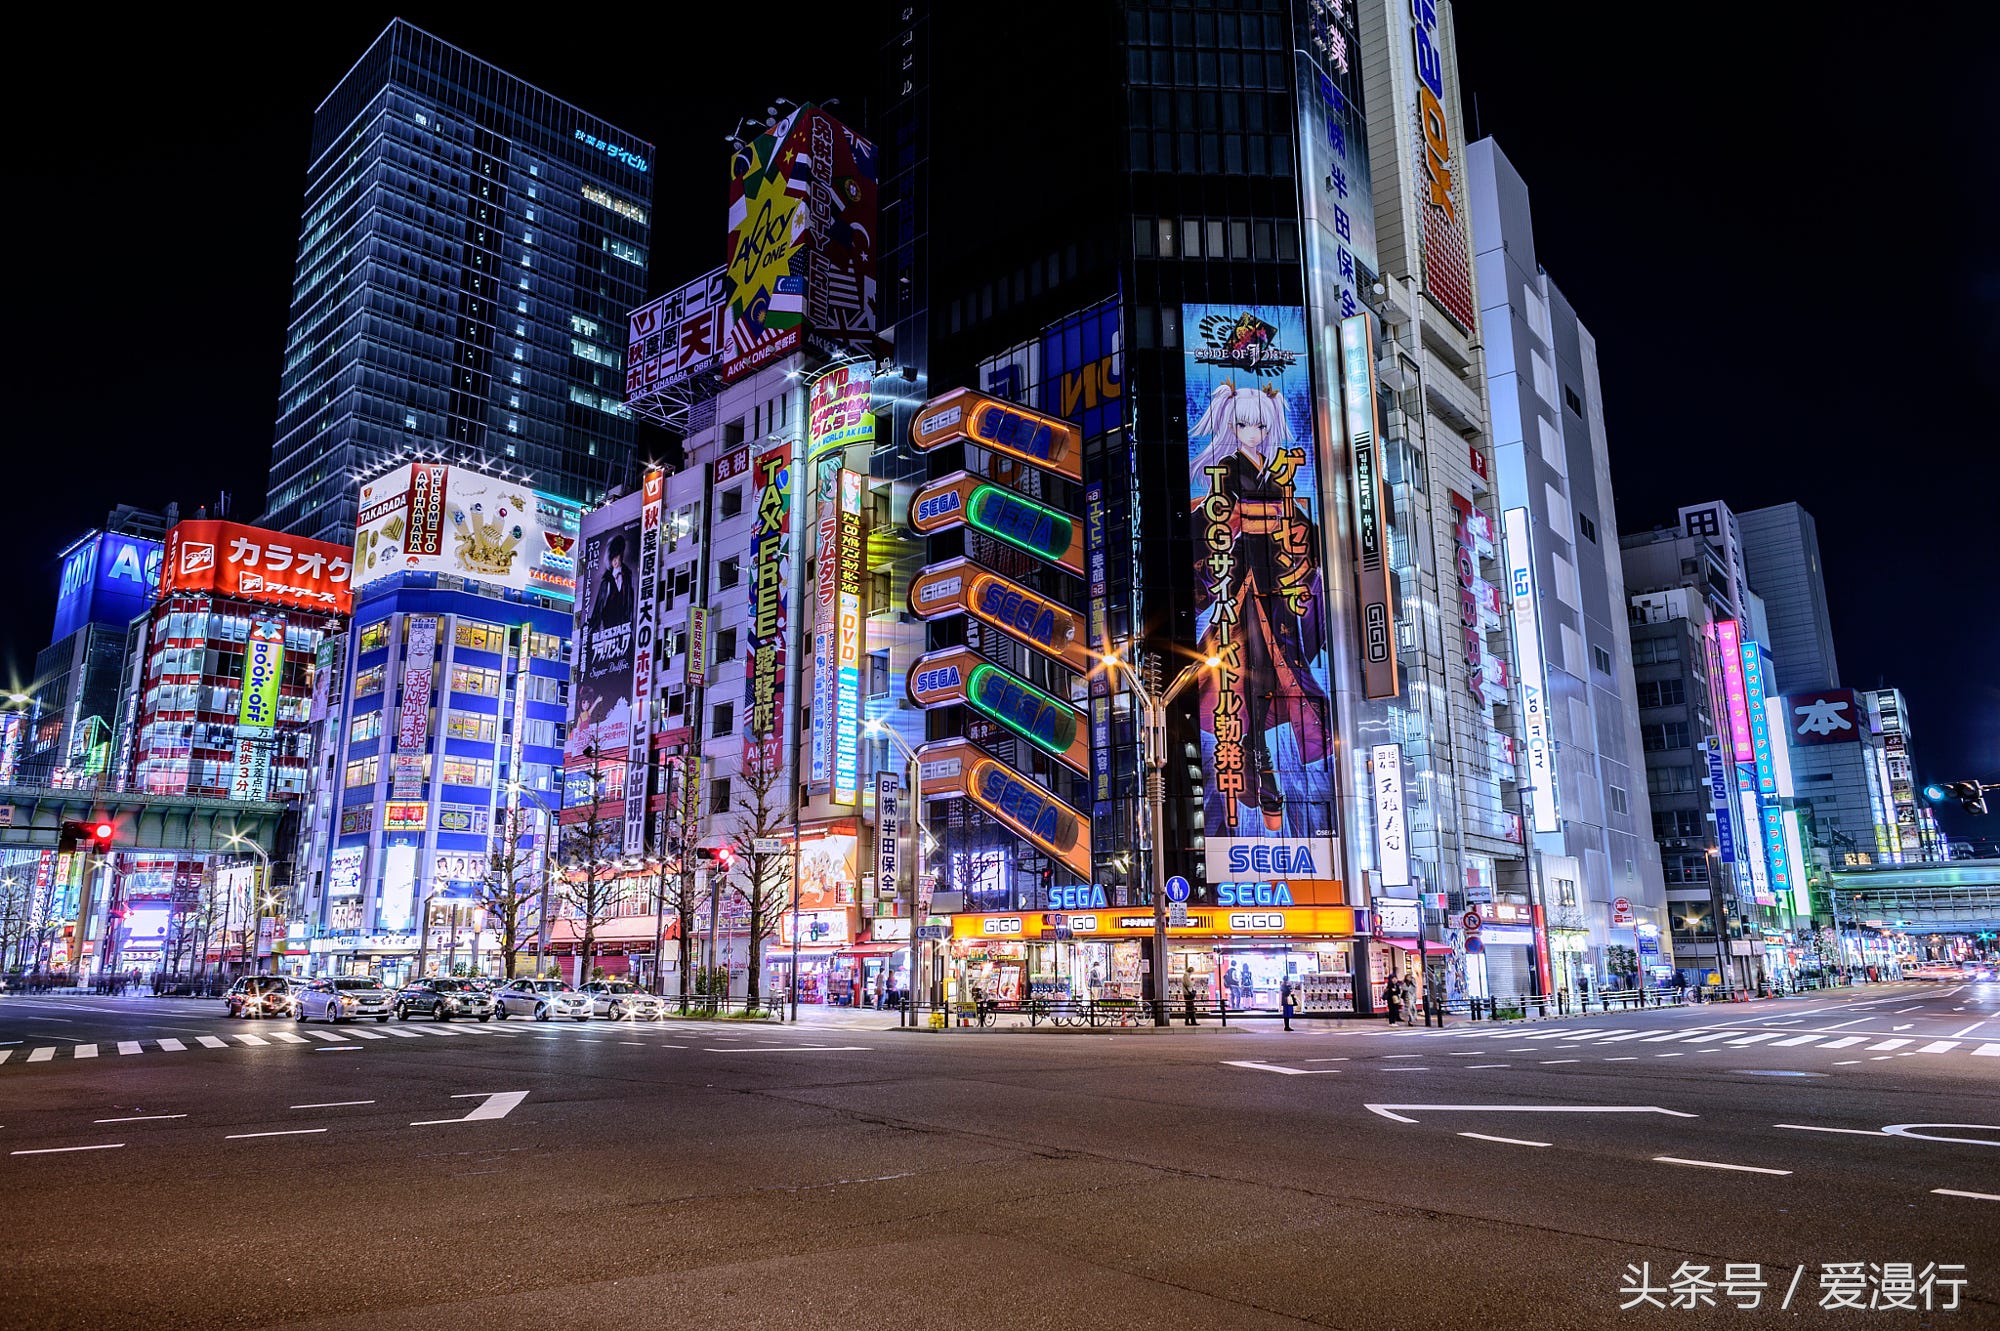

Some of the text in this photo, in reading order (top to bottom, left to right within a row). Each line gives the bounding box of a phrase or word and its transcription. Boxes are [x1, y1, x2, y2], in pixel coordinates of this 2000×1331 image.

[575, 129, 648, 172] 秋葉原ダイビル
[762, 242, 788, 268] ONE
[628, 327, 680, 365] 秋葉原
[1194, 343, 1297, 368] CODE OF JOKER
[627, 359, 678, 395] ホビー
[819, 367, 849, 391] DVD
[812, 411, 862, 440] ラムタラ
[822, 431, 844, 446] WORLD
[846, 425, 873, 439] AKIBA
[980, 408, 1053, 461] SEGA
[716, 451, 747, 480] 免税
[359, 494, 408, 525] TAKARADA
[408, 472, 428, 553] AKIHABARA
[424, 467, 443, 553] WELCOME TO
[760, 455, 784, 537] TAX
[918, 490, 960, 522] SEGA
[844, 525, 858, 536] CD
[981, 493, 1054, 550] SEGA
[1270, 447, 1312, 616] ゲーセンで
[60, 543, 96, 600] AOKI
[228, 537, 351, 583] カラオケ
[818, 517, 836, 606] ラムタラ
[756, 536, 780, 639] FREE
[1451, 490, 1487, 711] HOBBY
[980, 583, 1055, 645] SEGA
[842, 613, 856, 662] DVD
[917, 667, 960, 693] SEGA
[982, 674, 1057, 744] SEGA
[236, 740, 253, 792] 徒歩3分
[747, 742, 778, 760] AKKY
[881, 780, 898, 793] 8F
[1708, 752, 1727, 800] ALINCO
[981, 769, 1058, 846] SEGA
[881, 797, 898, 893] (株)半田保全
[1228, 845, 1317, 874] SEGA
[1048, 883, 1107, 911] SEGA
[1217, 881, 1295, 907] SEGA
